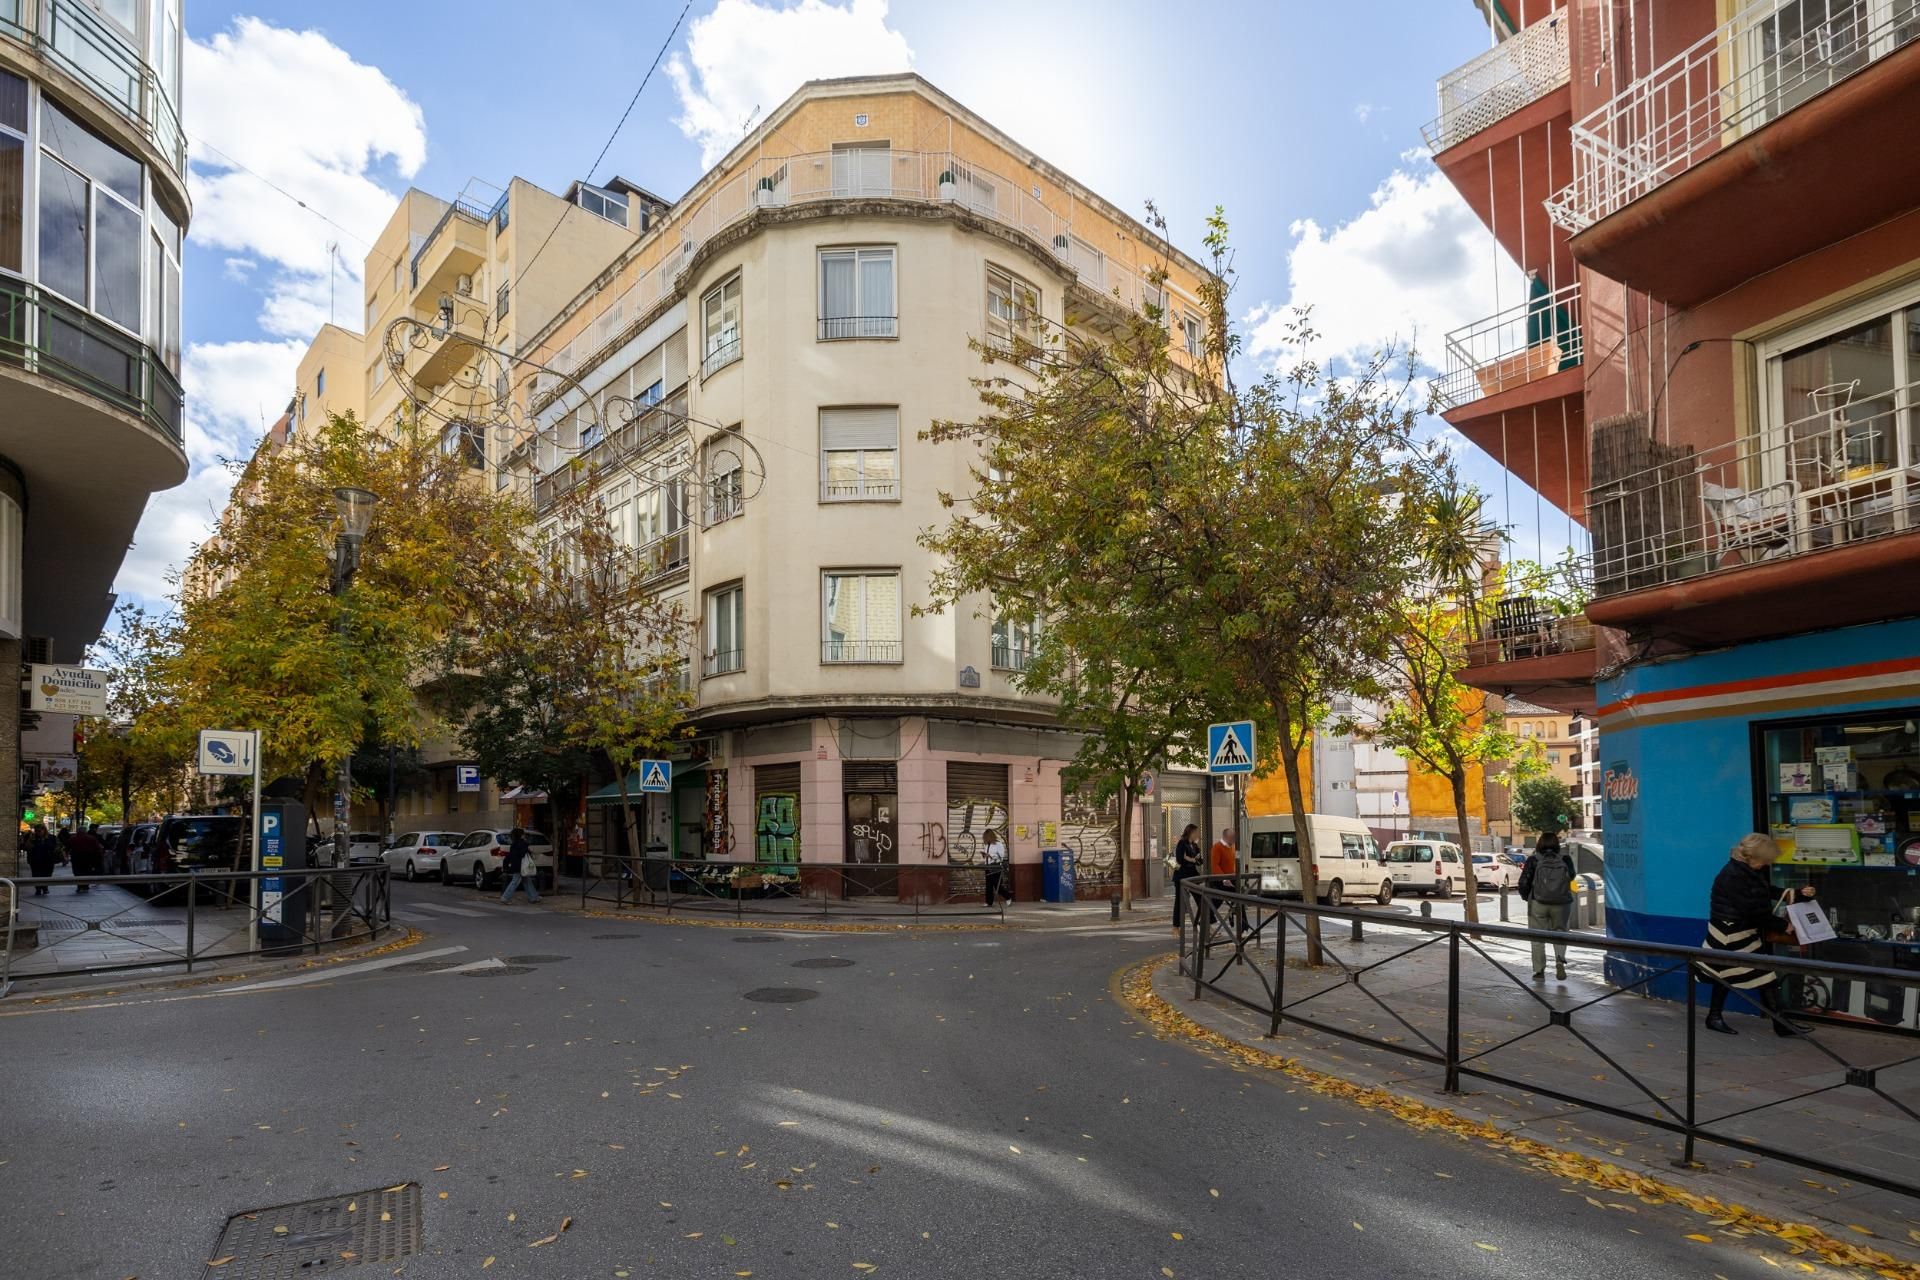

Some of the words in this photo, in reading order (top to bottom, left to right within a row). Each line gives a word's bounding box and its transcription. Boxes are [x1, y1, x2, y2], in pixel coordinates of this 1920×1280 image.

[42, 675, 101, 689] Domicilio
[52, 668, 92, 680] Ayuda
[460, 768, 478, 784] P
[1604, 768, 1639, 802] Fetén
[263, 815, 278, 833] P
